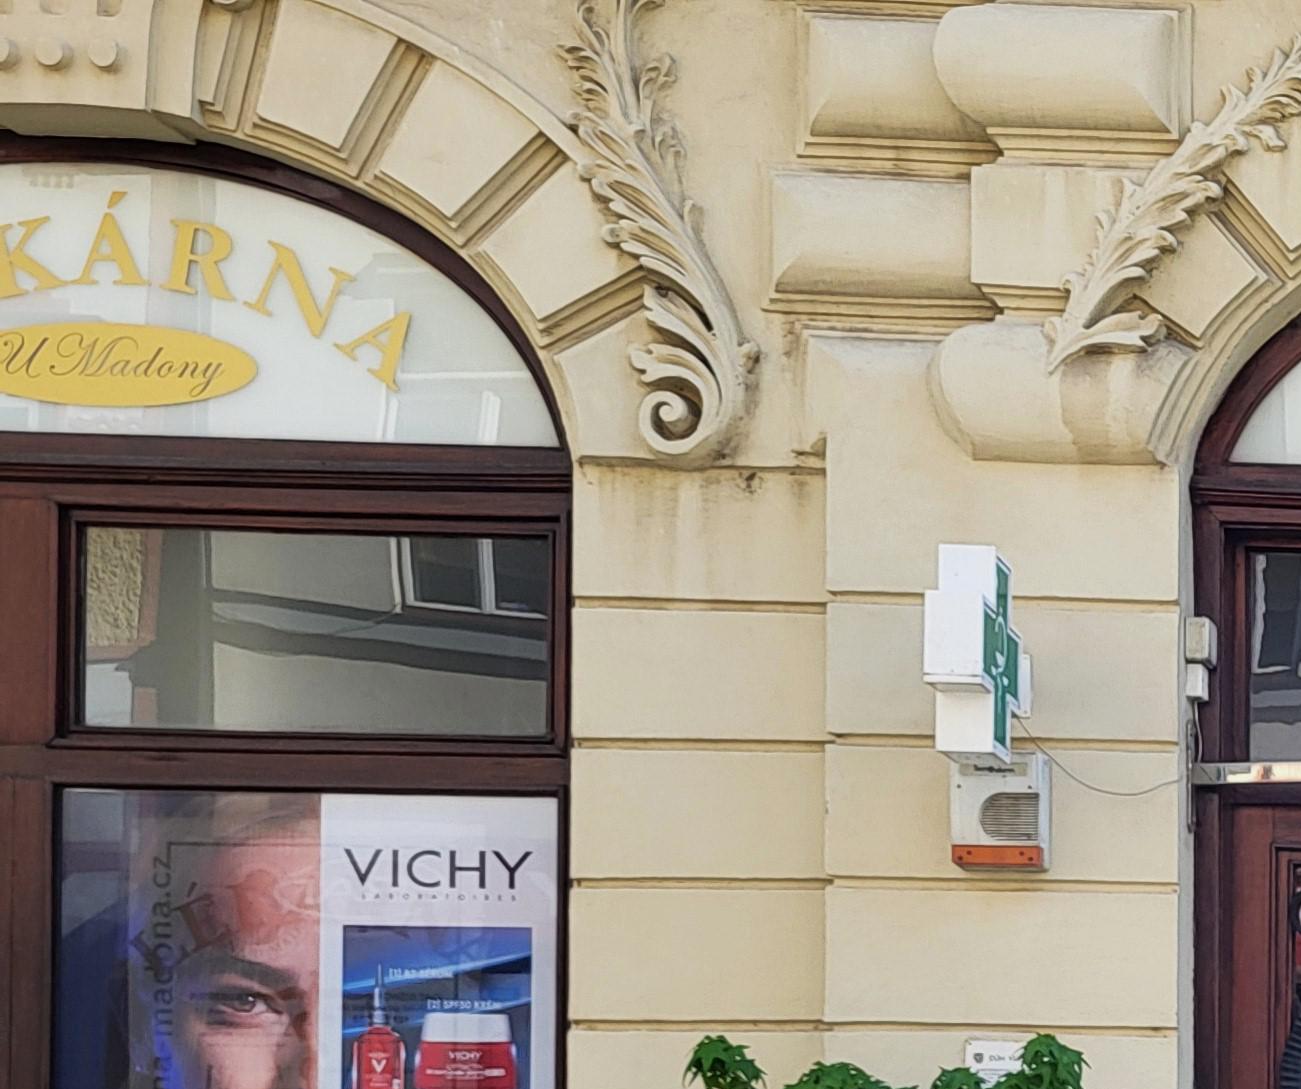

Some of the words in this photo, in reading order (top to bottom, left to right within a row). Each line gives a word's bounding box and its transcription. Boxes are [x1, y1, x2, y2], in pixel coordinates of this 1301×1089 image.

[49, 333, 225, 397] Madony
[343, 847, 534, 890] VICHY
[371, 1058, 388, 1074] V
